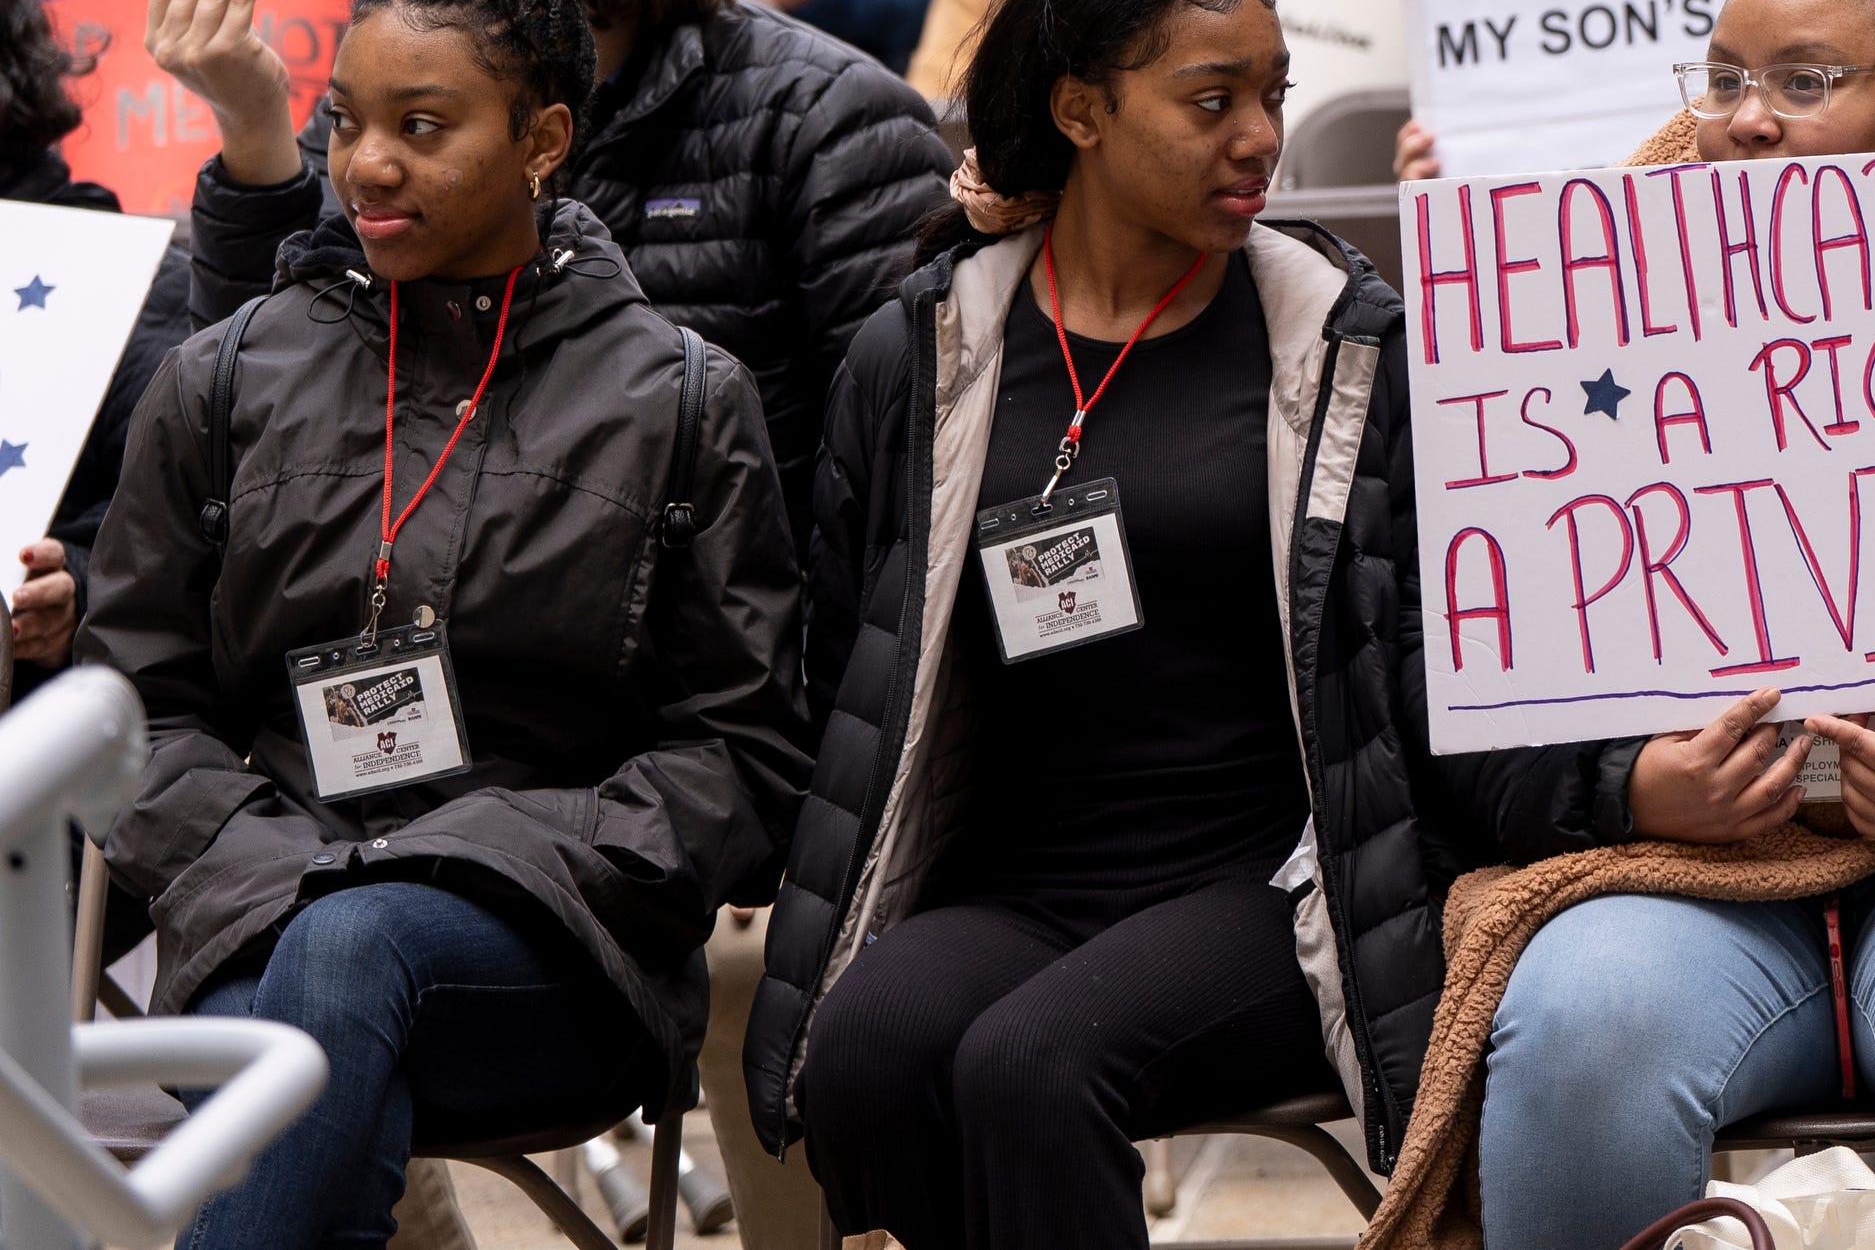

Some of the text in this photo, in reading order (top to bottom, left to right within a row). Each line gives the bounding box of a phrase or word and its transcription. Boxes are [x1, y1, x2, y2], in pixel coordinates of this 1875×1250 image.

[1438, 16, 1516, 68] MY
[1437, 387, 1579, 490] IS
[1654, 371, 1712, 465] A
[1037, 532, 1080, 563] PROTECT
[1040, 535, 1090, 570] MEDICAID
[1044, 554, 1075, 576] RALLY
[1061, 598, 1074, 611] ACI
[1443, 526, 1514, 673] A
[1036, 603, 1098, 624] ALLIANCE CENTER
[1046, 609, 1100, 629] INDEPENDENCE
[356, 672, 403, 702] PROTECT
[360, 676, 414, 710] MEDICAID
[363, 693, 397, 716] RALLY
[353, 744, 420, 764] ALLIANCE CENTER
[380, 736, 394, 750] ACI
[363, 750, 421, 769] INDEPENDENCE
[1795, 773, 1840, 783] SPECIAL
